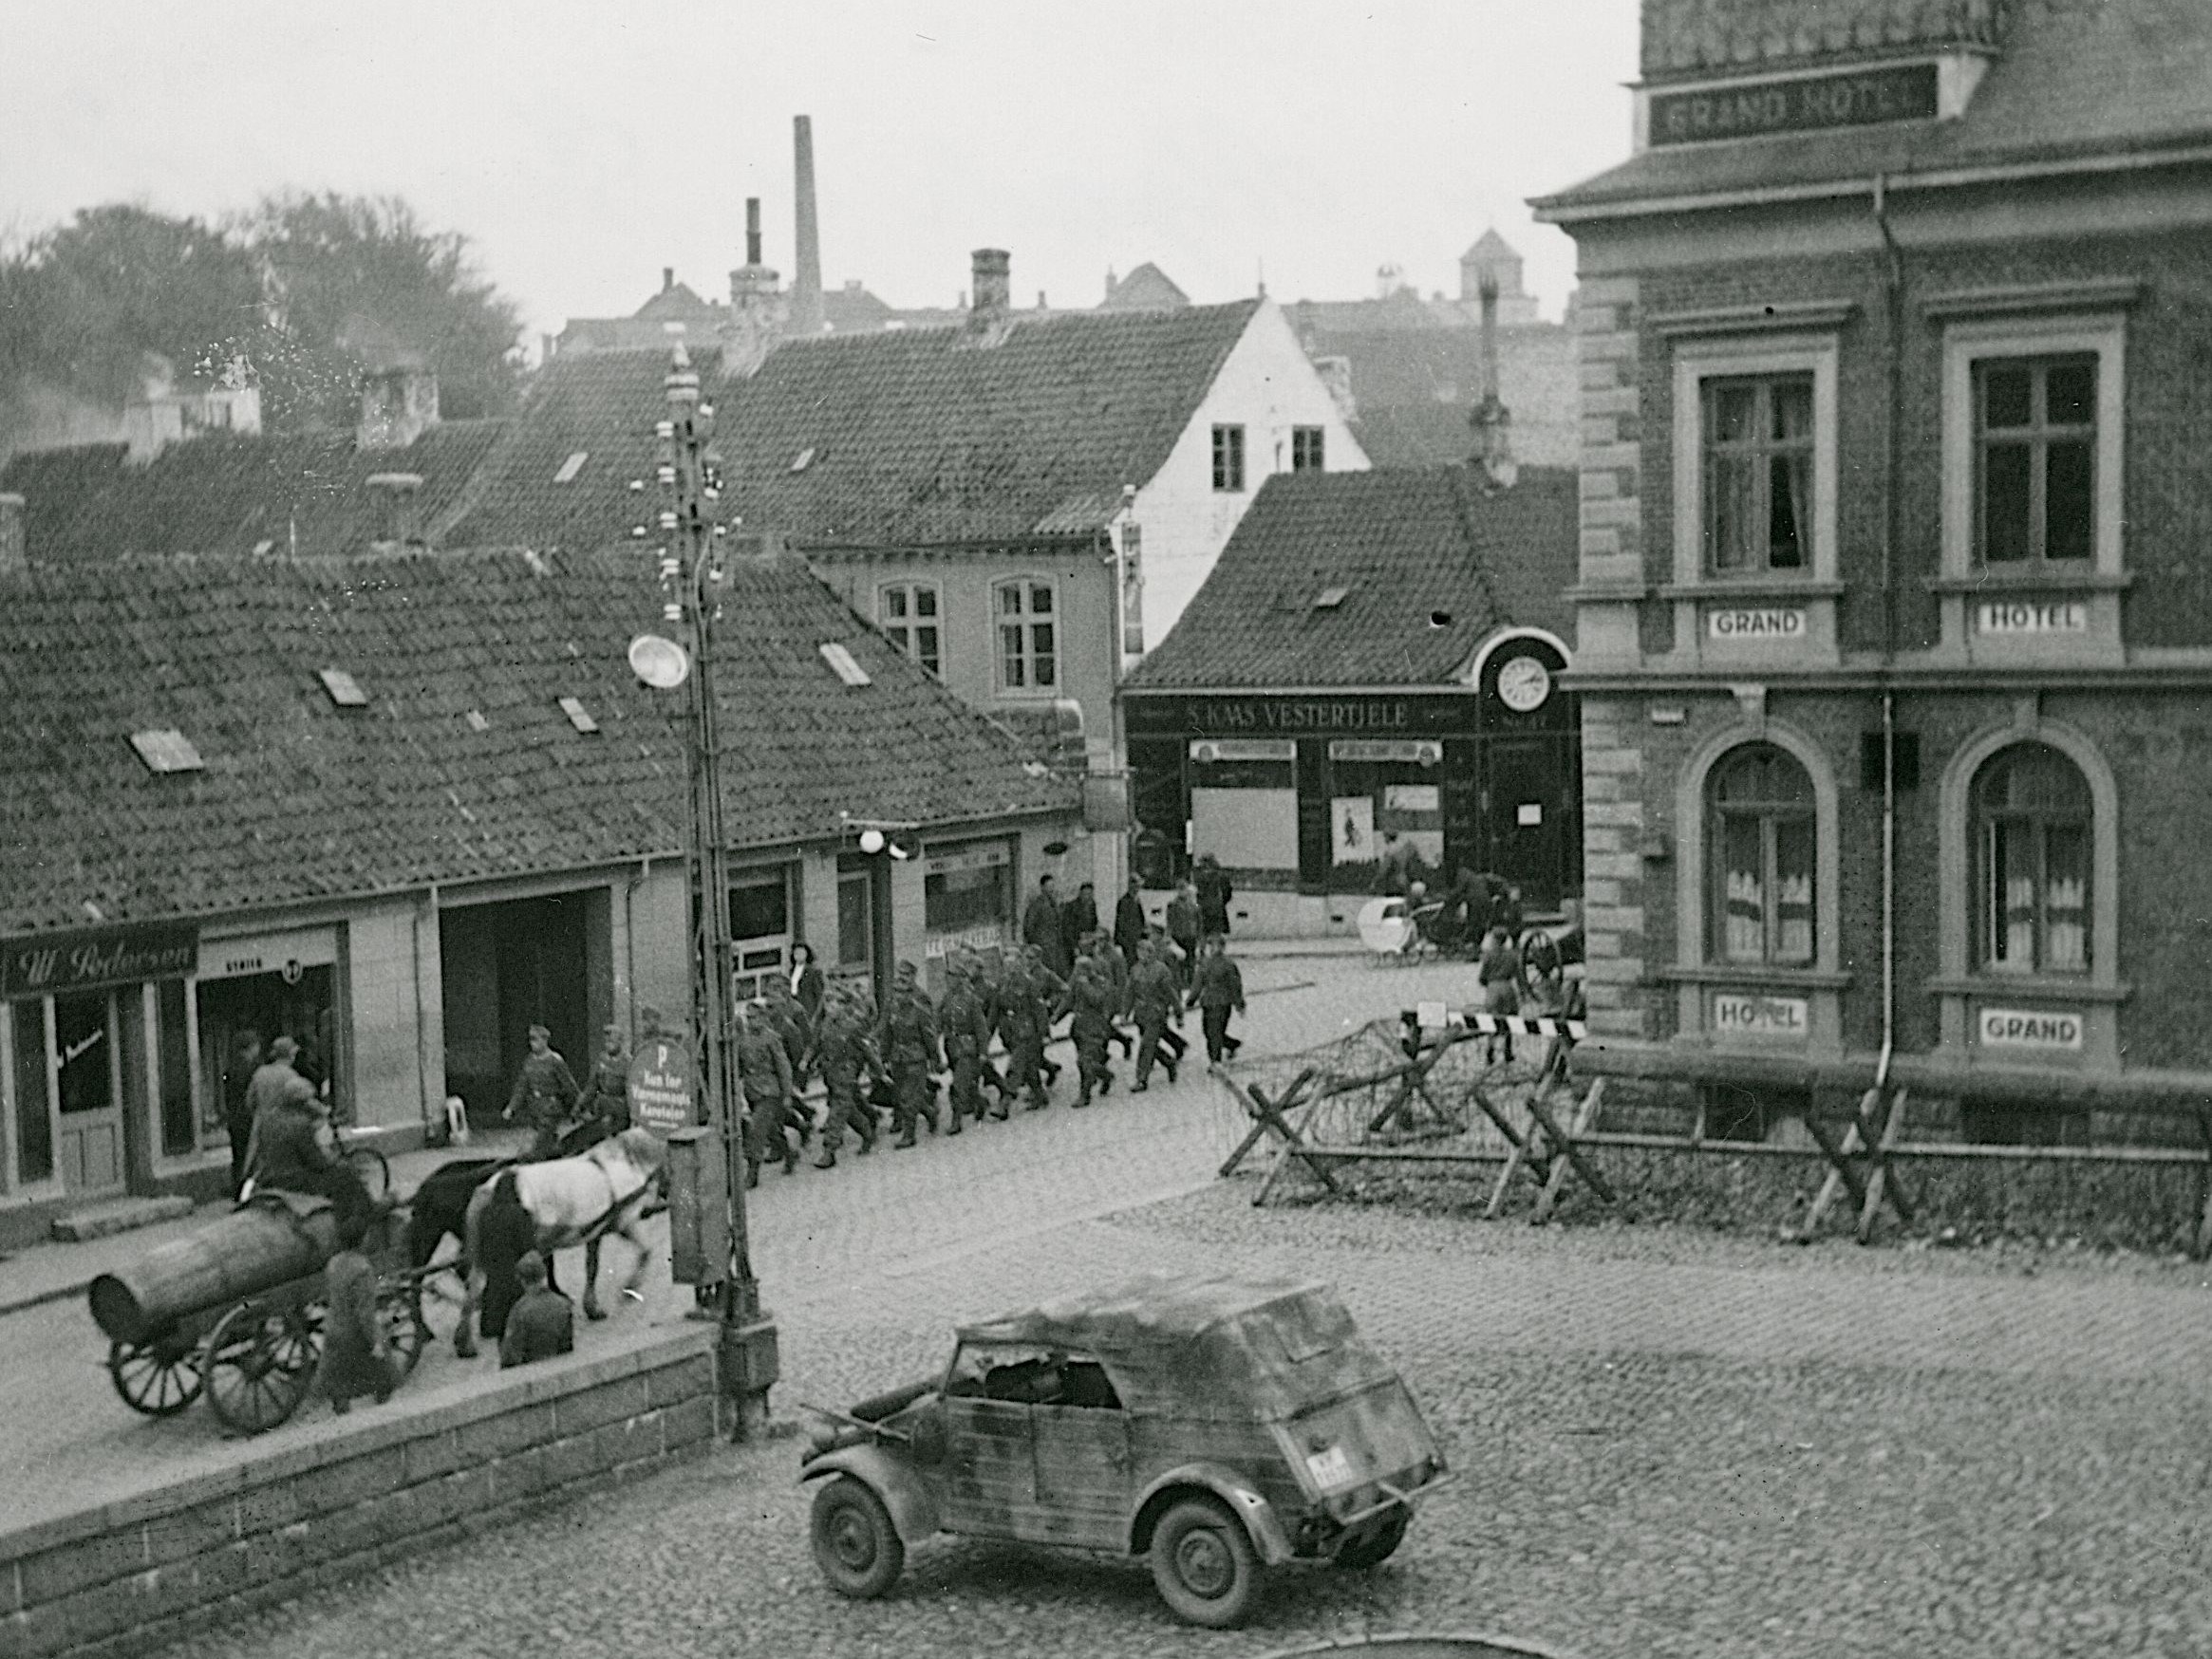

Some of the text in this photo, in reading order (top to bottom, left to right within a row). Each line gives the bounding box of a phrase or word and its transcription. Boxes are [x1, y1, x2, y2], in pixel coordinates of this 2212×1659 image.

[1667, 76, 1912, 136] GRAND HOTEL
[1716, 613, 1799, 634] GRAND
[1991, 605, 2080, 627] HOTEL
[1987, 1016, 2077, 1042] GRAND
[657, 1045, 667, 1069] P
